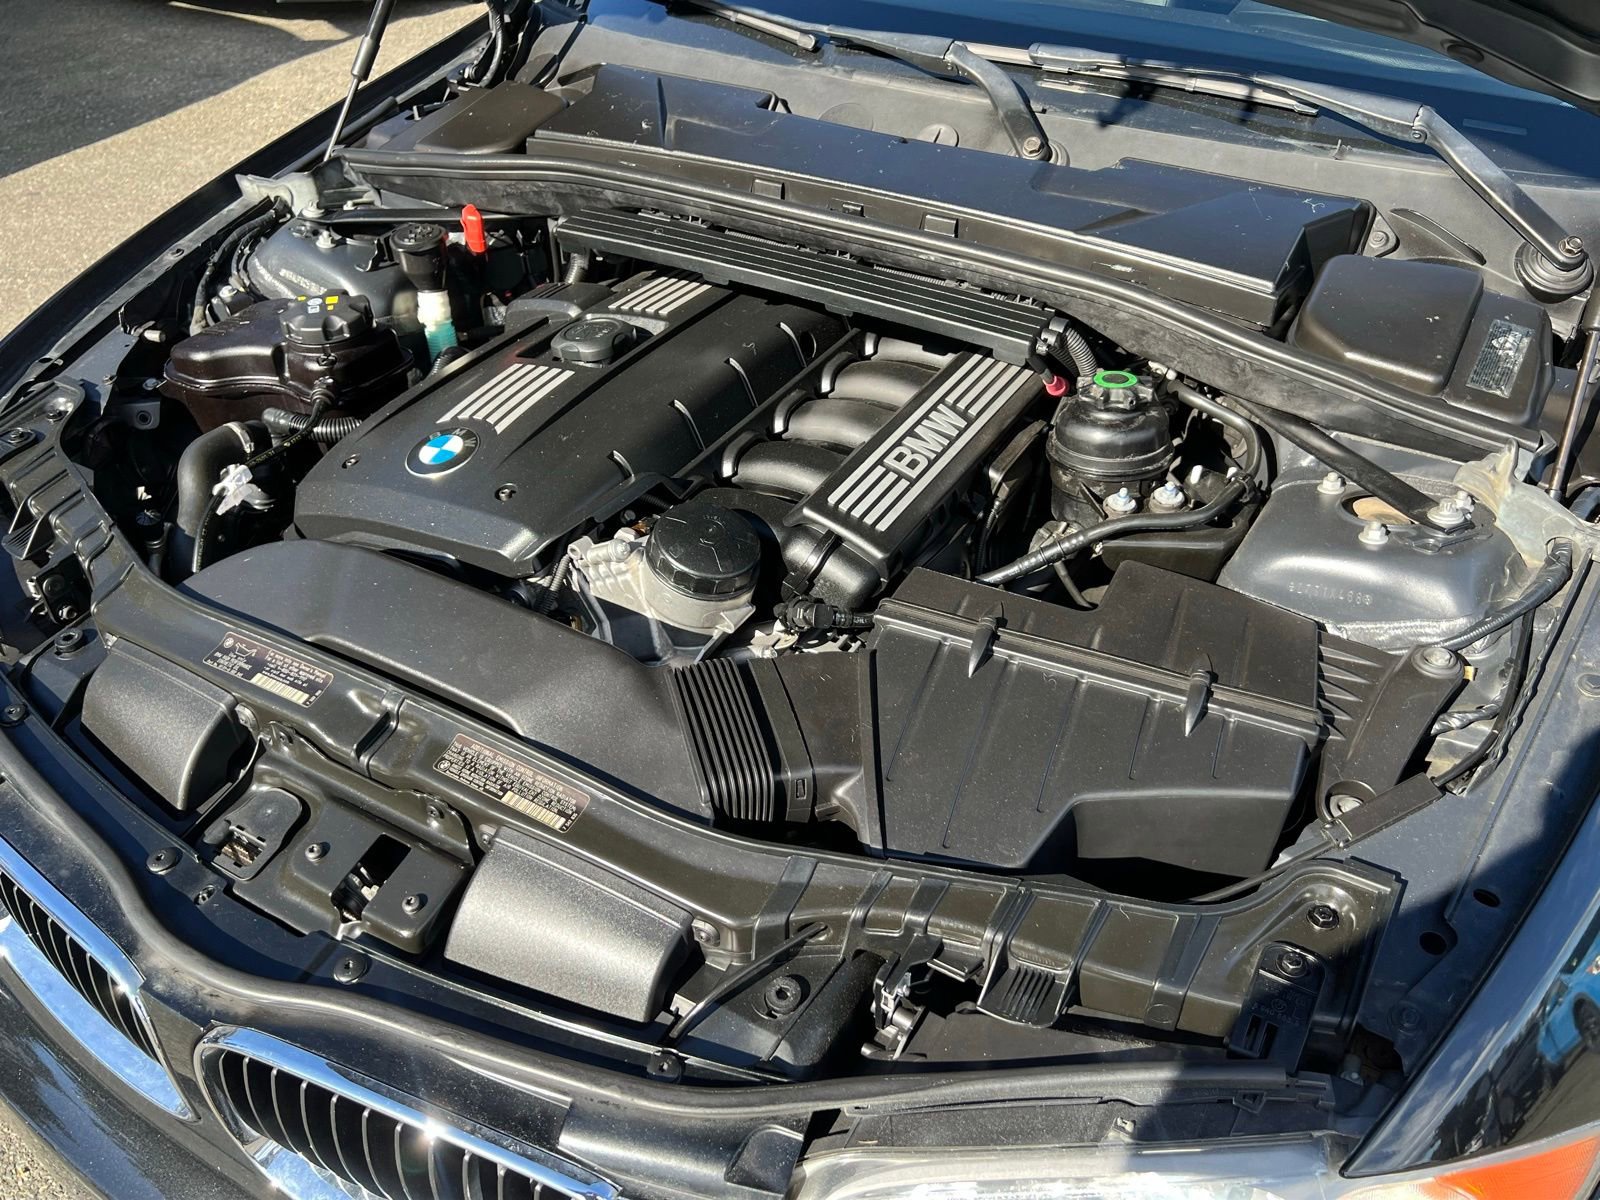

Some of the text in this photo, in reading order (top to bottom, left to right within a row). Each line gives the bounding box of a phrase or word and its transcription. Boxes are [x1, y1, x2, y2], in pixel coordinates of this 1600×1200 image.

[883, 403, 967, 479] BMW
[494, 754, 516, 768] EMISSION
[515, 764, 535, 777] CONTROL
[534, 774, 564, 791] INFORMATION
